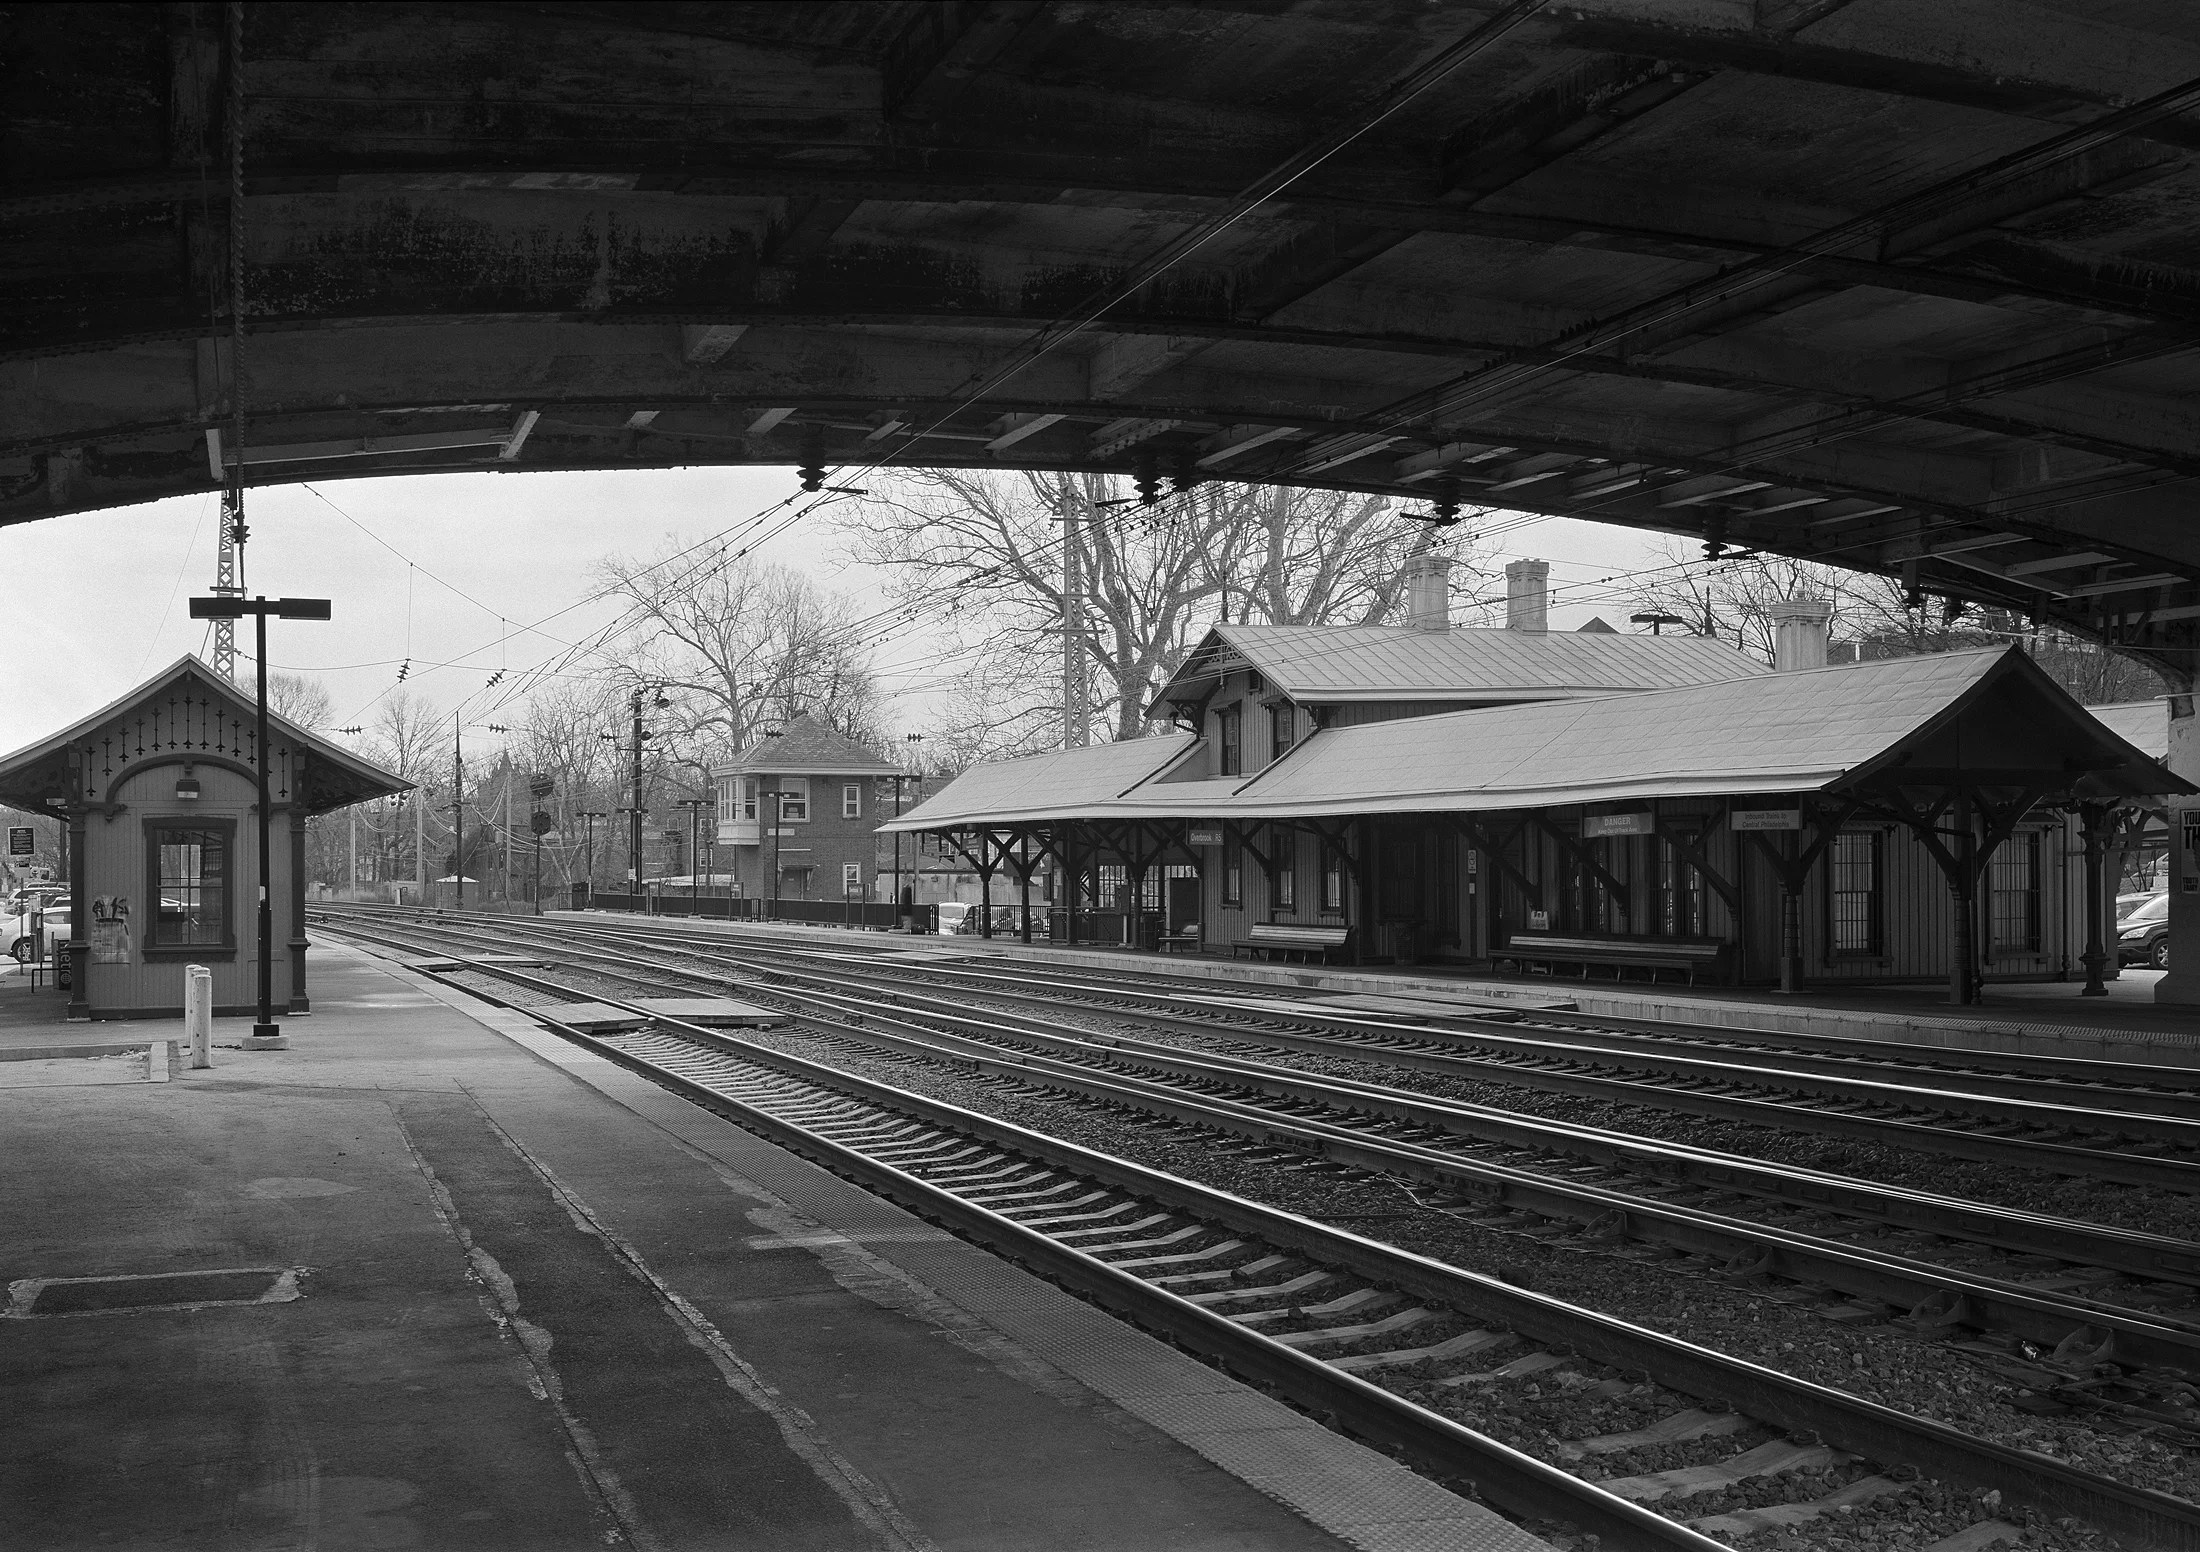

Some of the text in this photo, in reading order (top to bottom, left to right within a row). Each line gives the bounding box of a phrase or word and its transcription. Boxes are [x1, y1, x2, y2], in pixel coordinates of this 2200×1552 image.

[1604, 817, 1631, 826] DANGER
[1761, 820, 1790, 828] Philadelphia
[1191, 832, 1222, 842] Overbrook R5
